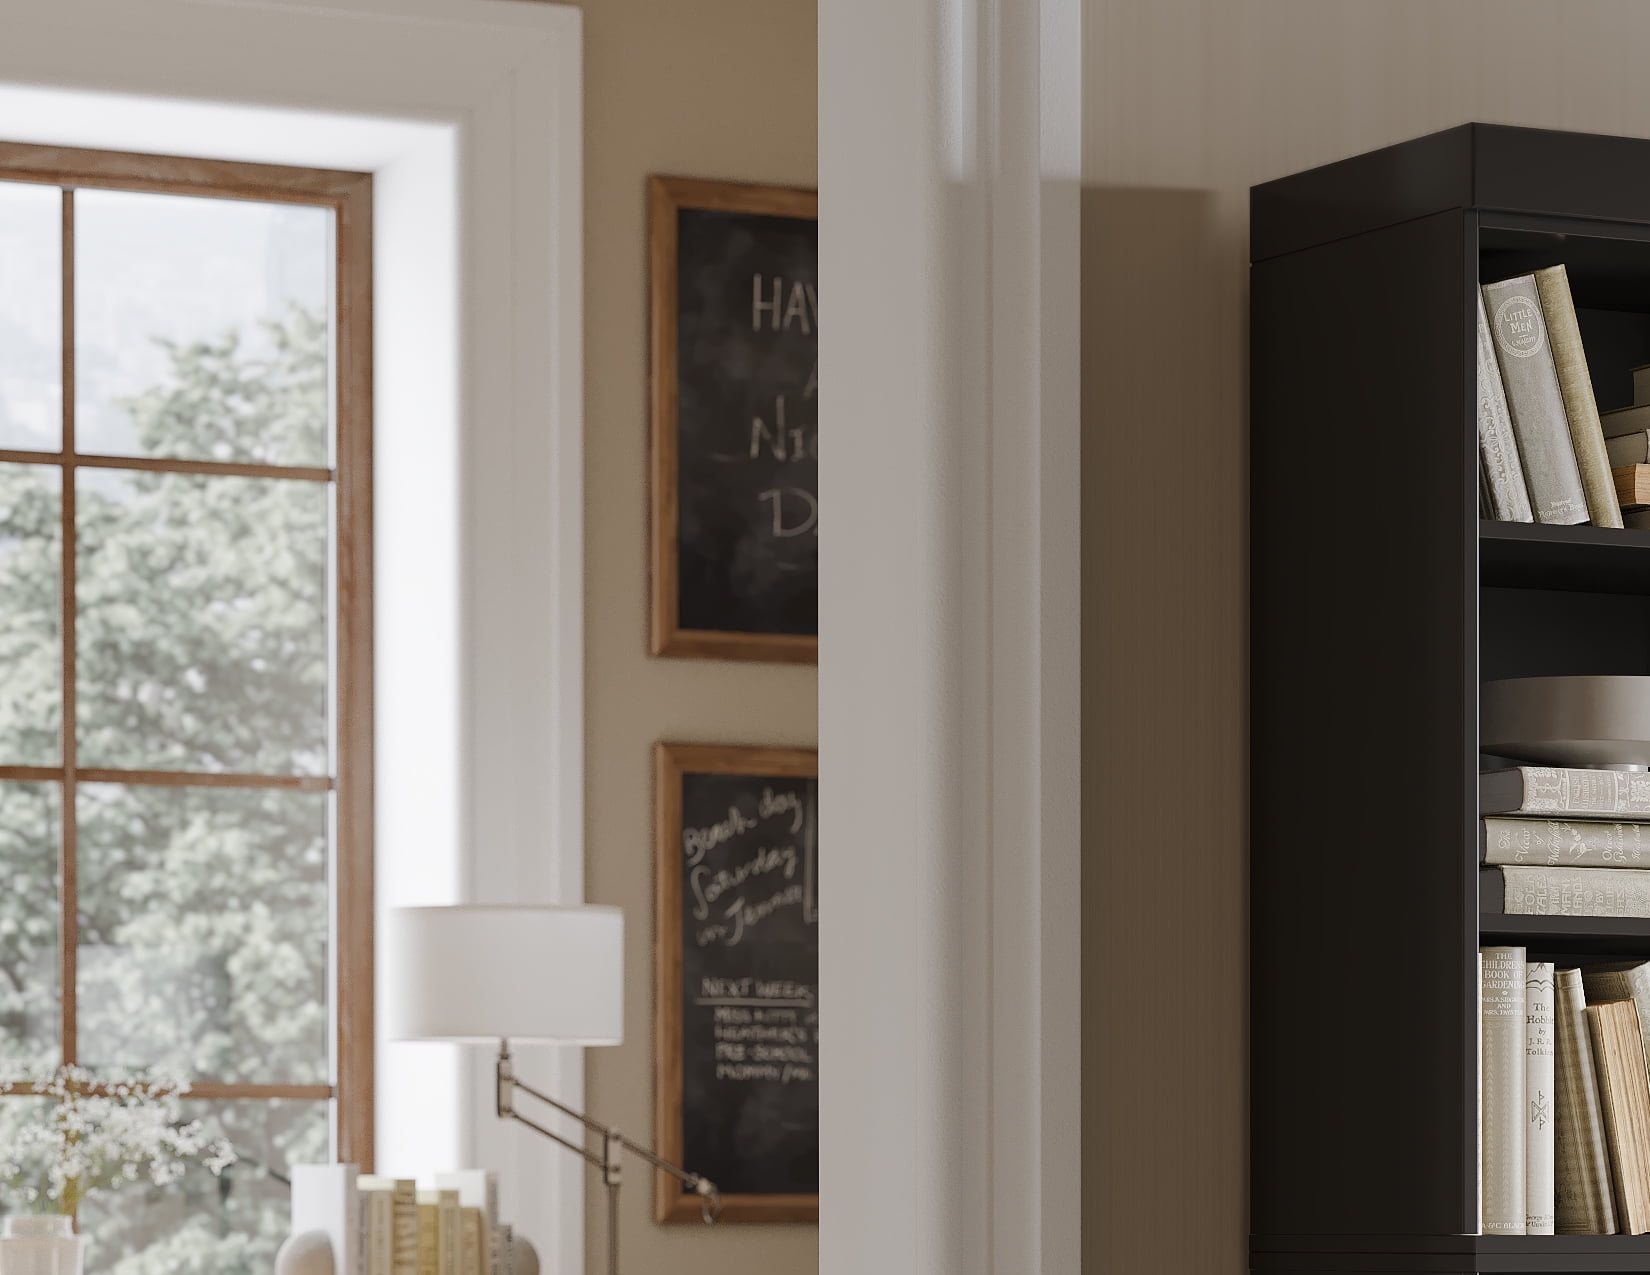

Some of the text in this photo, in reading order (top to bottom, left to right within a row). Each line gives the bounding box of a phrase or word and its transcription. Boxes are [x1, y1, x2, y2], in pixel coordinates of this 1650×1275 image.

[1503, 308, 1533, 322] LITTLE
[1510, 320, 1533, 335] MEN
[750, 395, 818, 463] NI
[758, 487, 818, 537] D
[1495, 952, 1513, 960] THE
[1484, 969, 1510, 979] BOOK
[702, 977, 753, 998] NEXT
[1538, 1027, 1547, 1038] by
